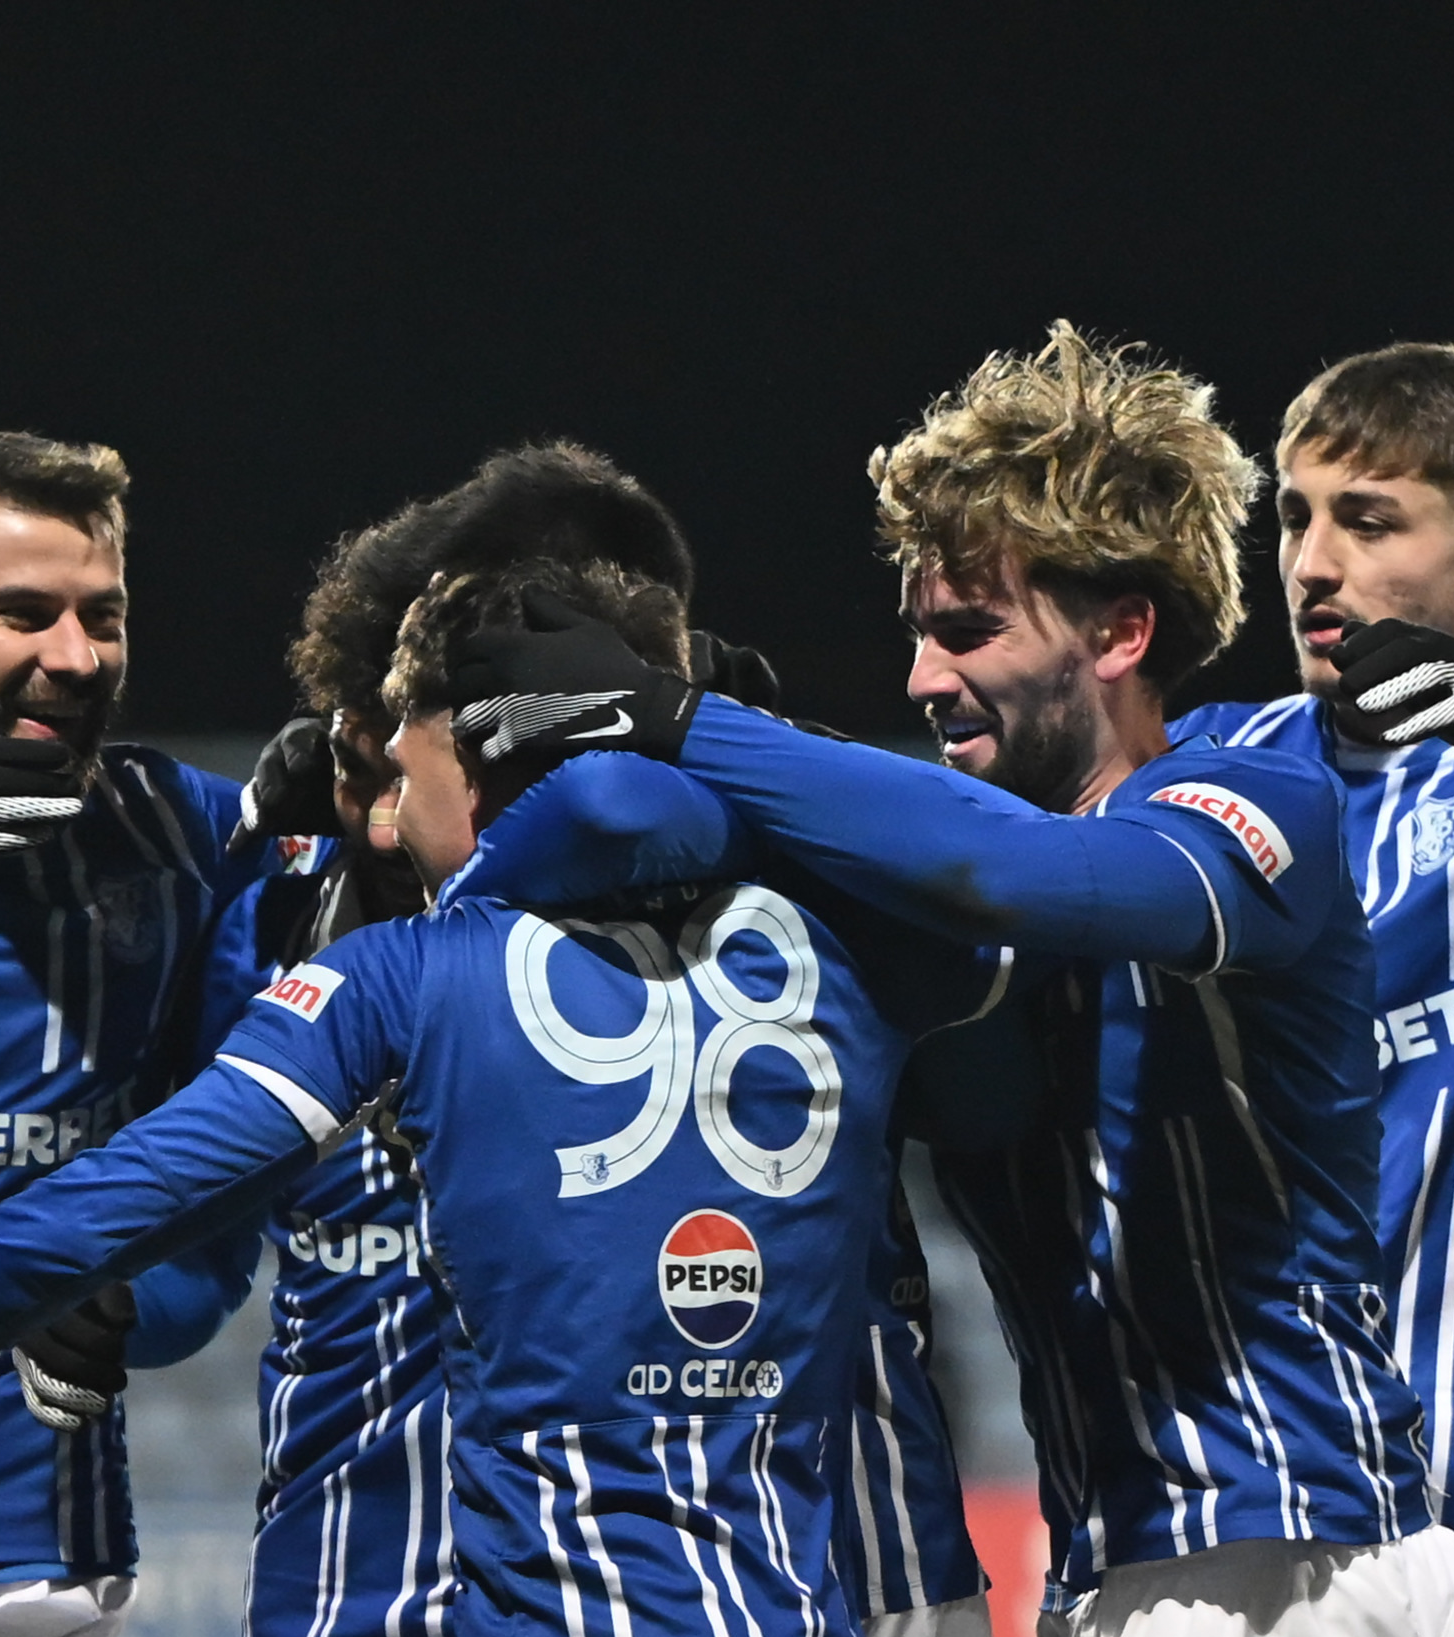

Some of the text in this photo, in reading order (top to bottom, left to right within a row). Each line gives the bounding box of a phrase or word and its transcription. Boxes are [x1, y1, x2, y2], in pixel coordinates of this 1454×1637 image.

[263, 978, 322, 1013] an
[506, 884, 842, 1198] 98
[665, 1264, 756, 1293] PEPSI
